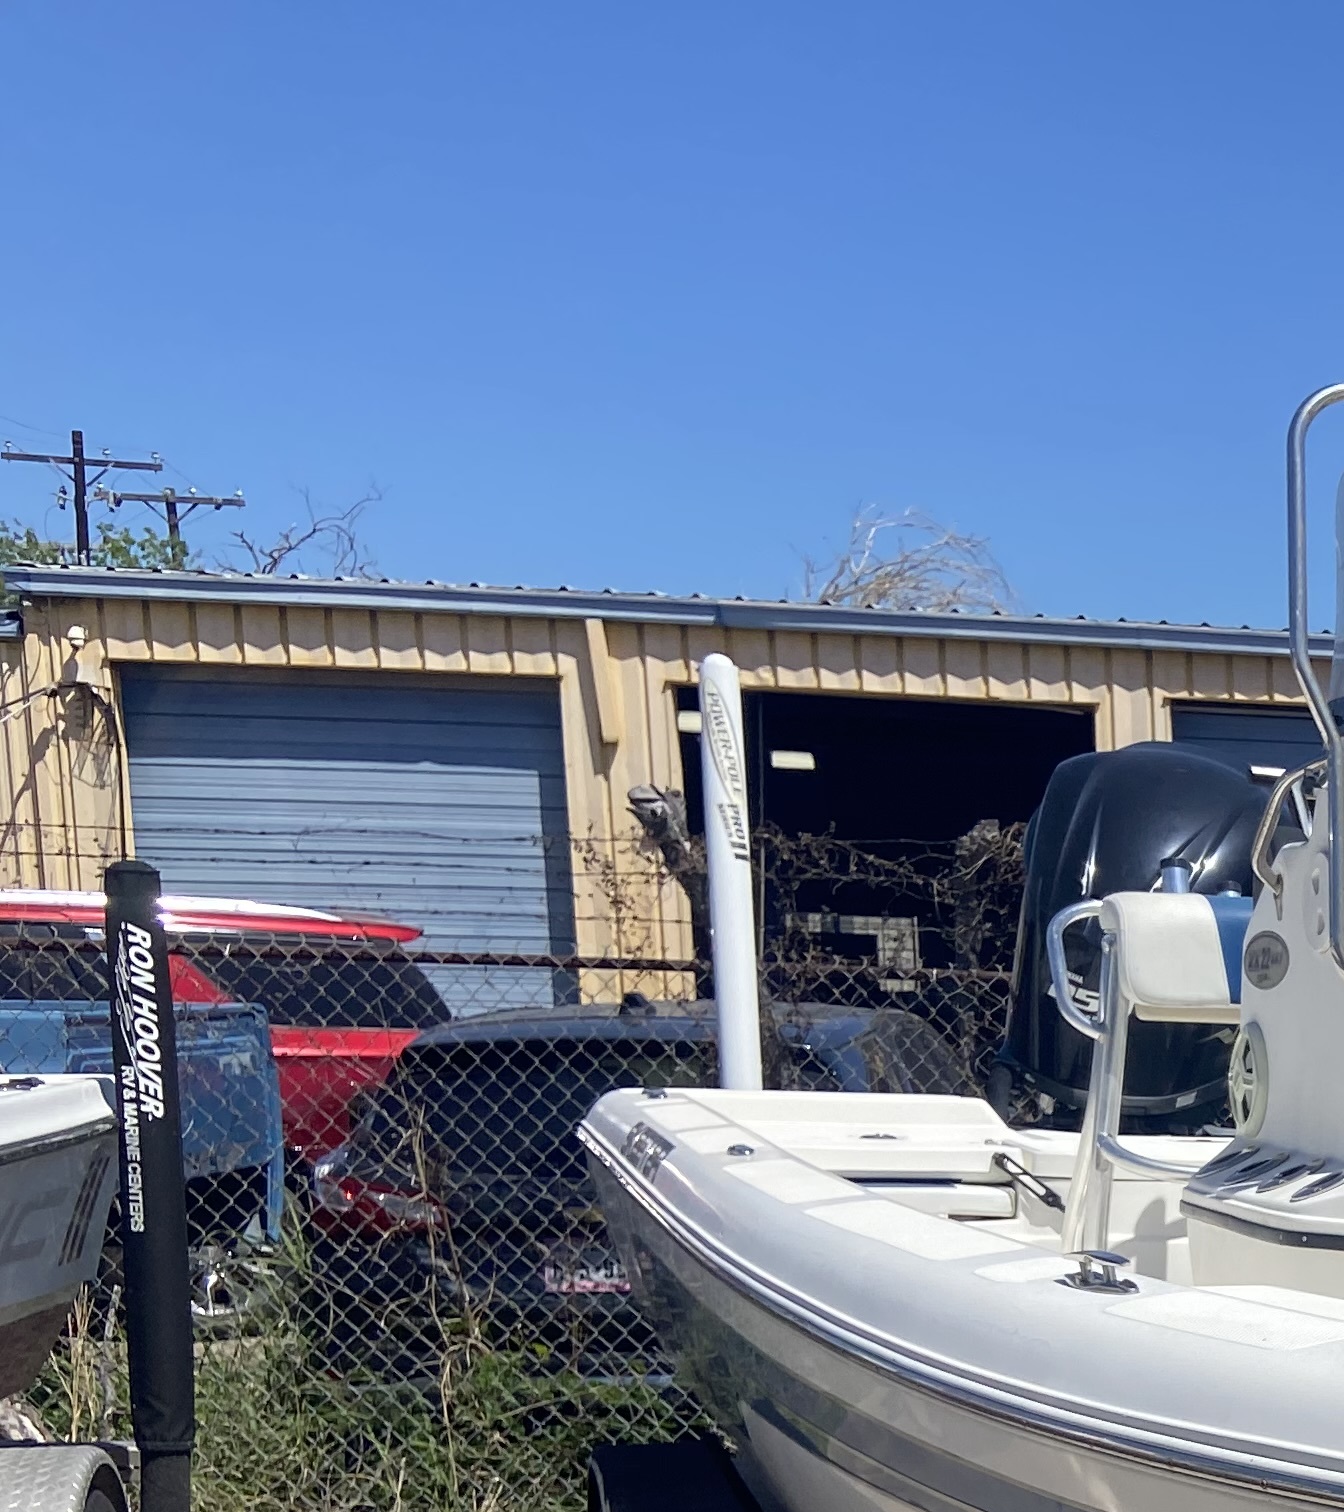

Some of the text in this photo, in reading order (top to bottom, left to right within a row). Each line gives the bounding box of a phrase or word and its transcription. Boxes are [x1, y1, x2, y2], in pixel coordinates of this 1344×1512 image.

[127, 922, 165, 1120] RON HOOVER
[121, 1064, 145, 1233] RV & MARINE CENTERS
